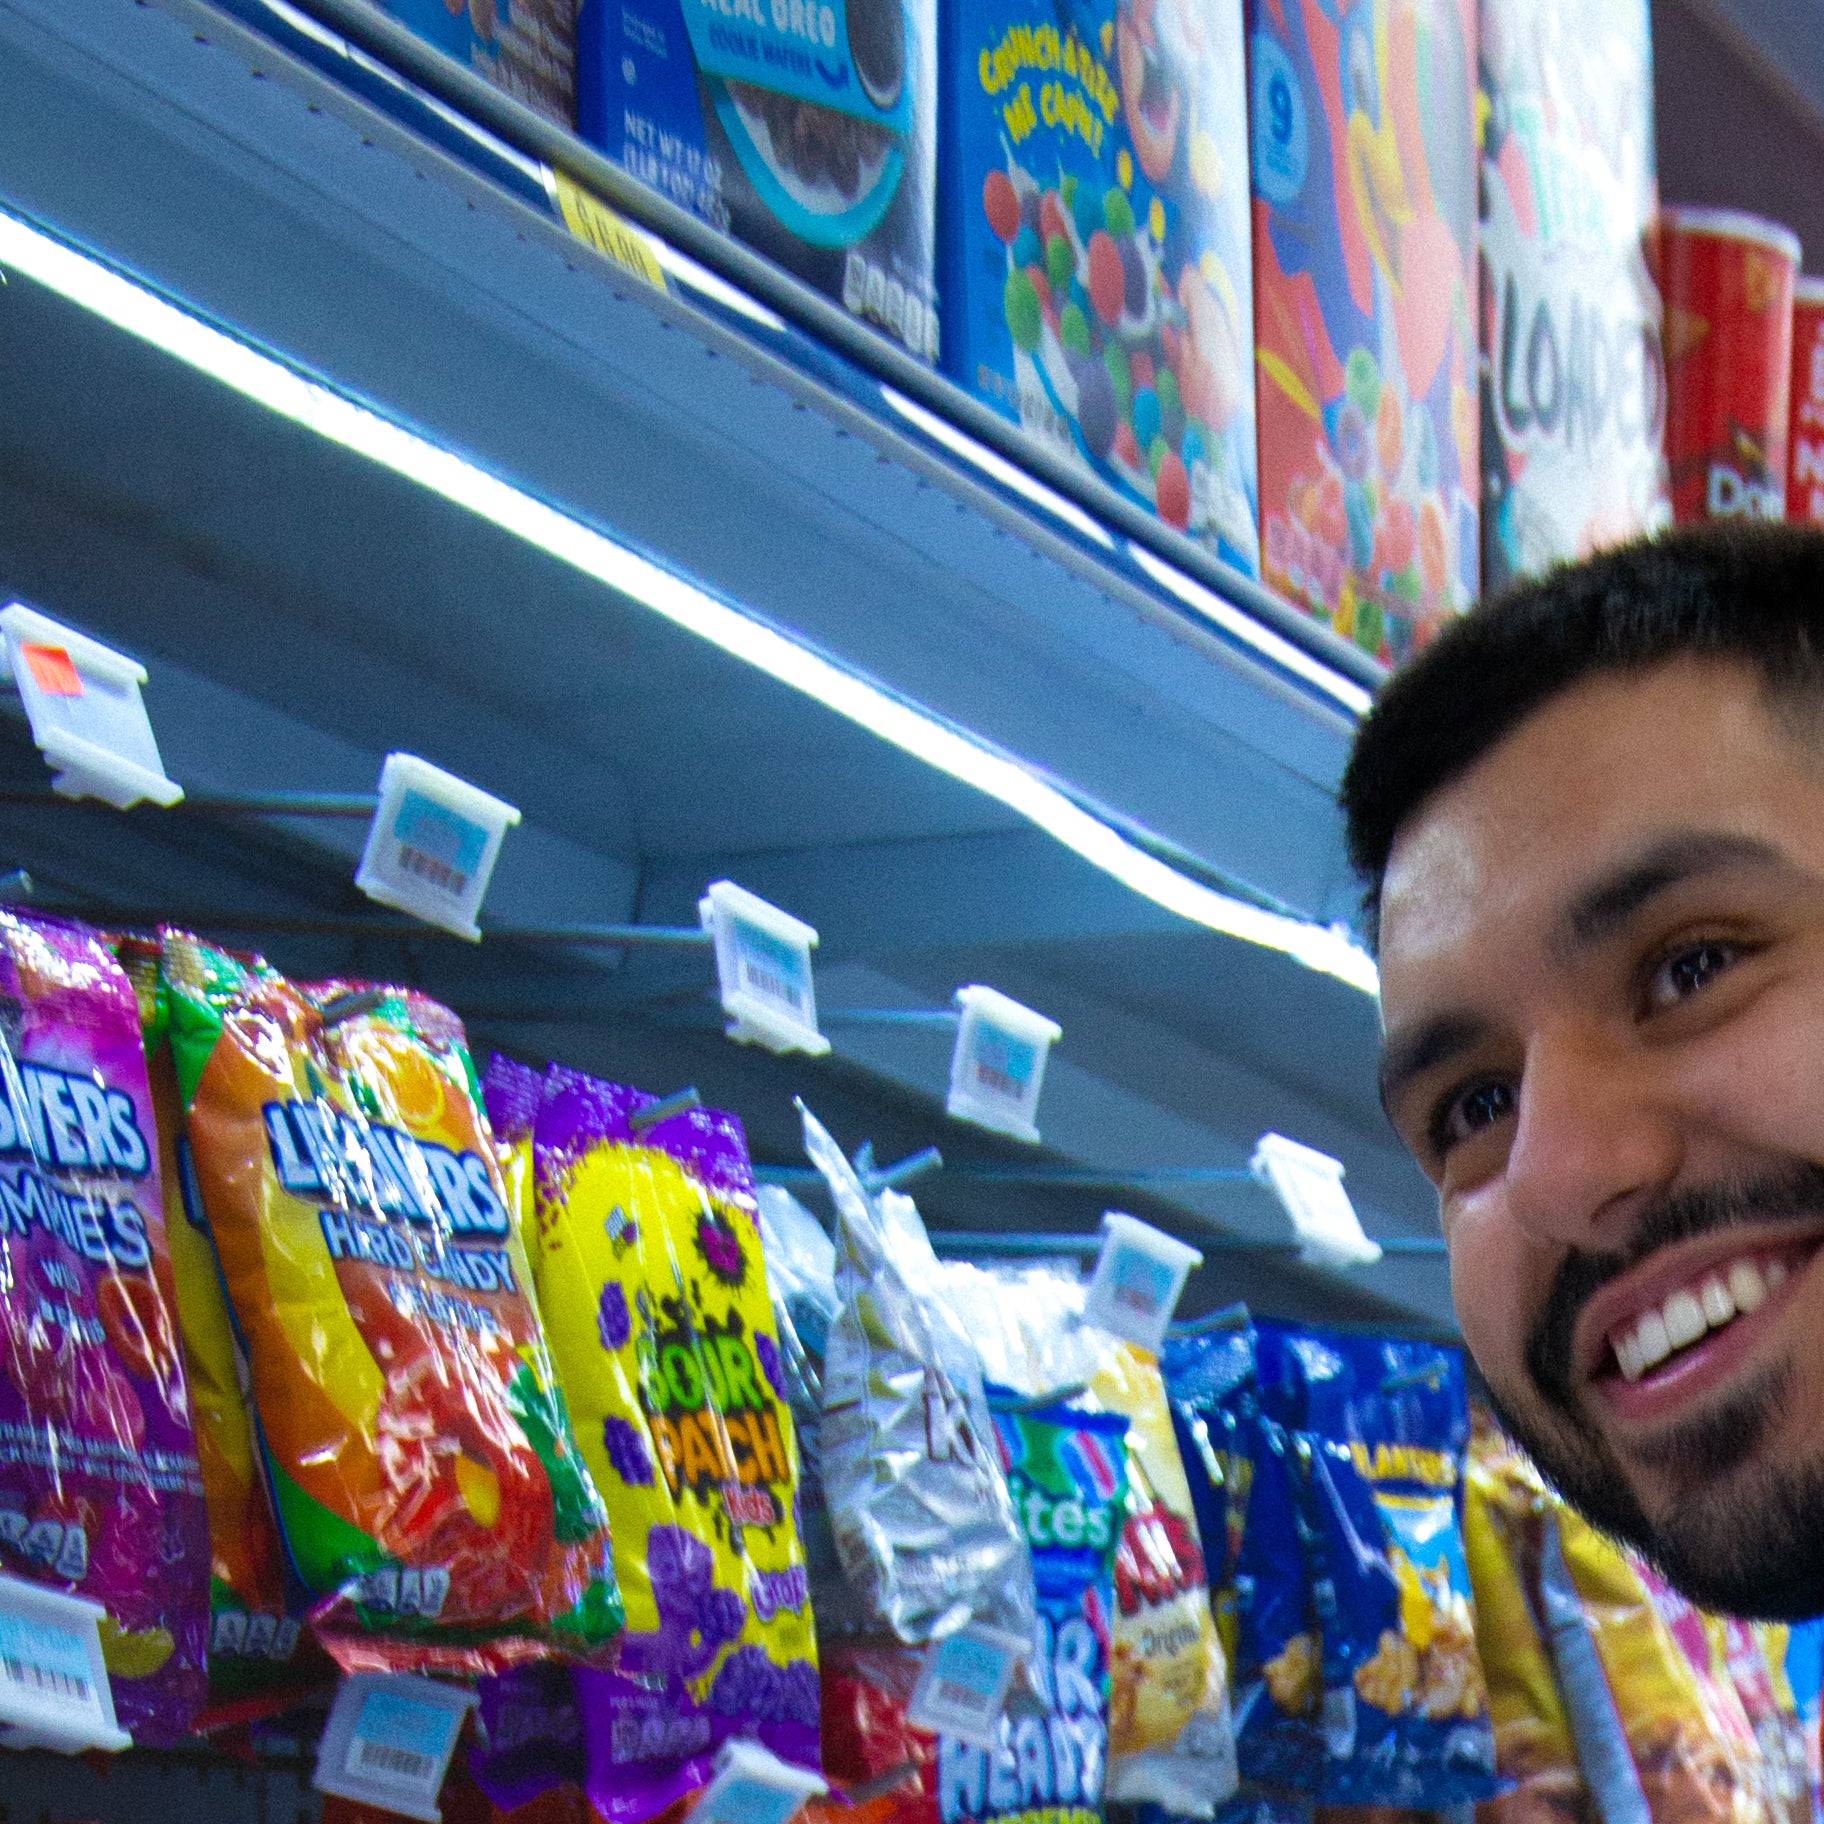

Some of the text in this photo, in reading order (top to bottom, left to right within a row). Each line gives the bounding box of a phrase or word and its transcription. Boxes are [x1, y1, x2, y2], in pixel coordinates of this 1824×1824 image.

[636, 1330, 762, 1412] SOUR
[650, 1405, 782, 1497] PATCH
[1010, 1476, 1112, 1548] ites
